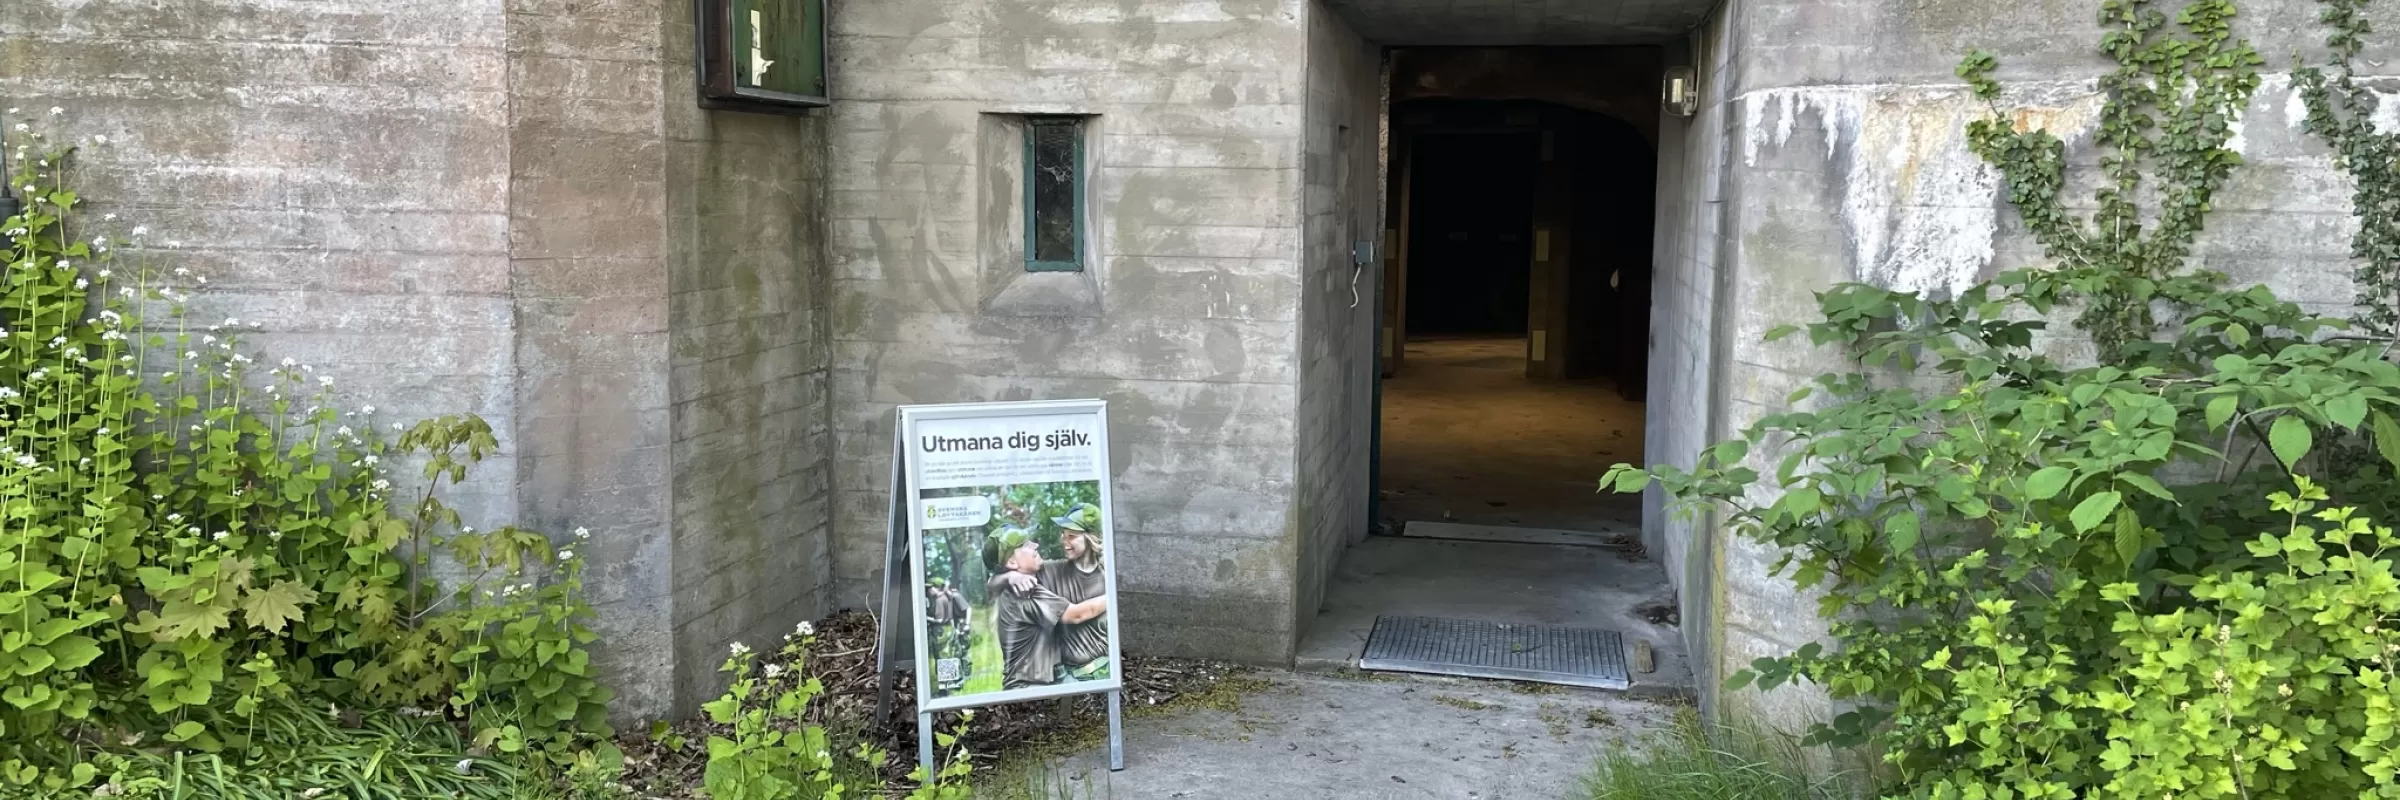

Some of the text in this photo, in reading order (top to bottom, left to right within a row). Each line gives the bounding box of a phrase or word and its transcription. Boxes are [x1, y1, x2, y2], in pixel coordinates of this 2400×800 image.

[922, 429, 1091, 452] Utmana dig själv.
